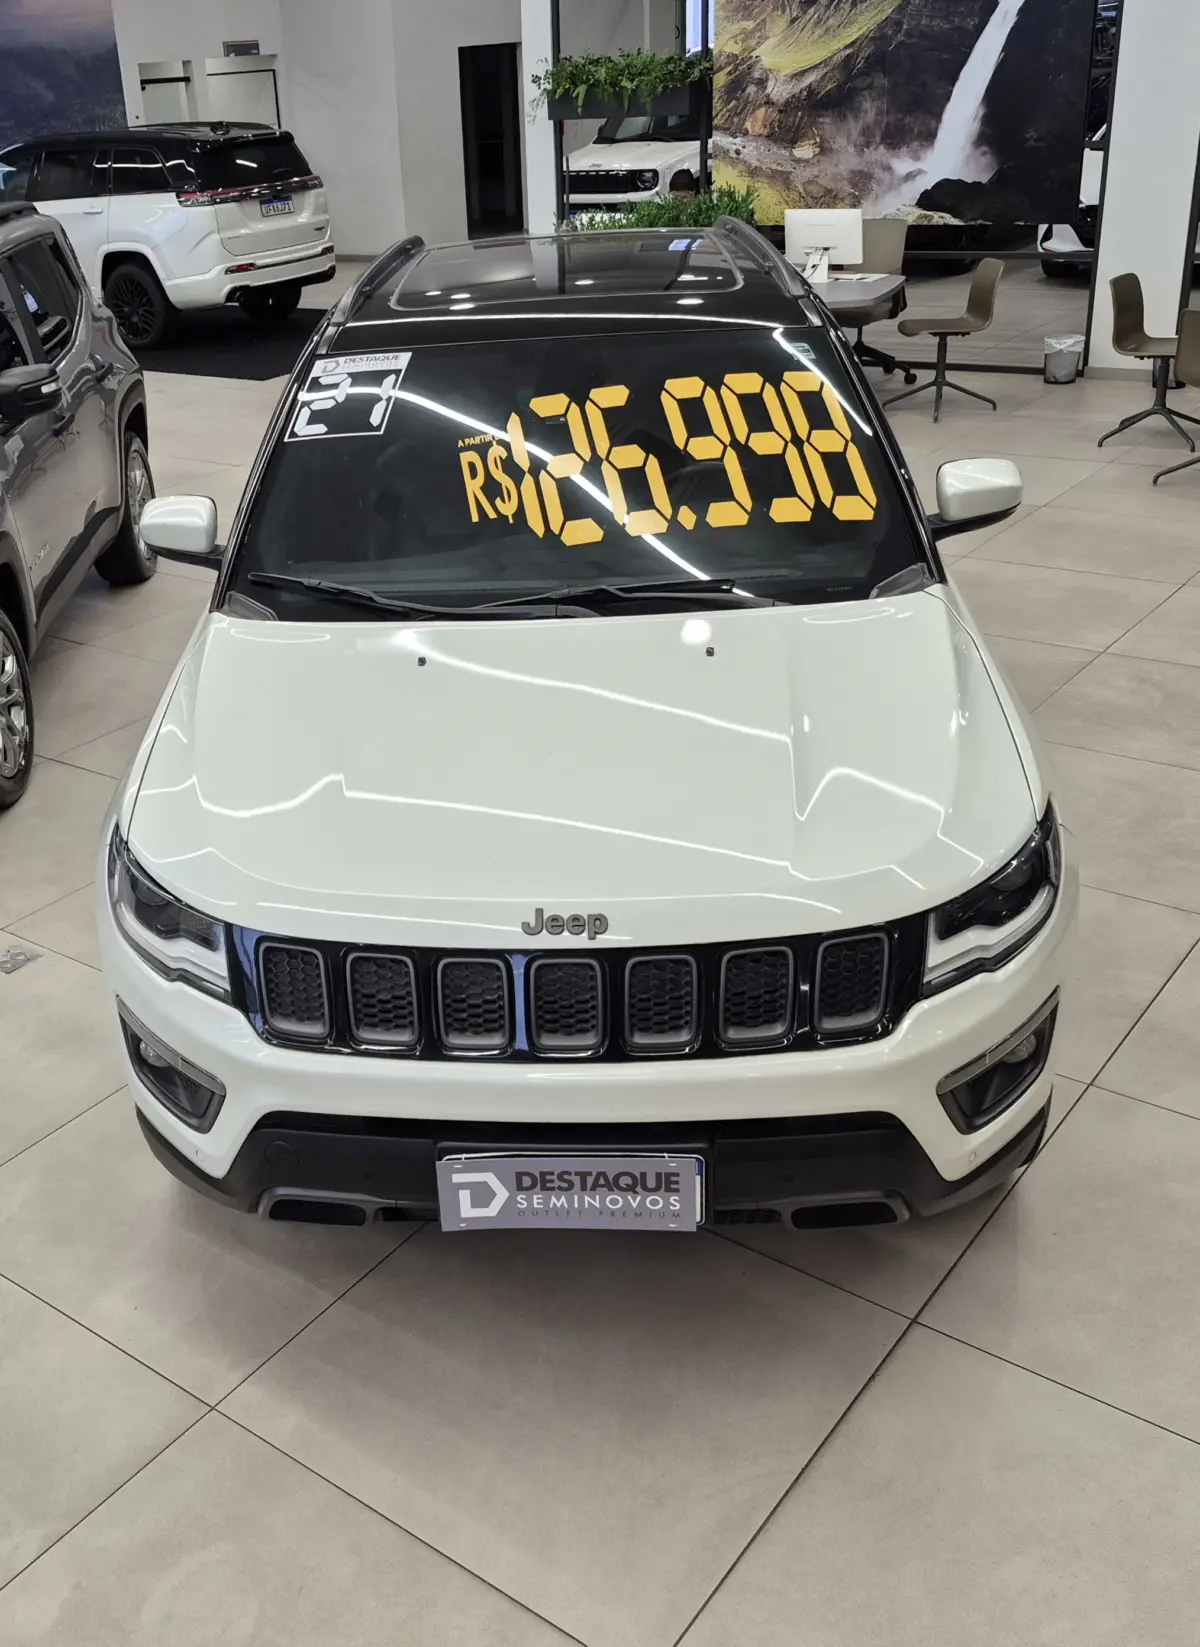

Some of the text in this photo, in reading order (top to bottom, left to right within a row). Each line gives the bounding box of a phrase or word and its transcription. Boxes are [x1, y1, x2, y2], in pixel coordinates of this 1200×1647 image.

[344, 354, 401, 364] DESTAQUE
[293, 373, 396, 437] 21
[457, 439, 465, 448] A
[464, 433, 493, 446] PARTIR
[521, 907, 609, 941] Jeep
[514, 1171, 681, 1195] DESTAQUE
[516, 1194, 681, 1210] SEMINOVOS
[517, 1210, 681, 1219] OUTLET PREMIUM
